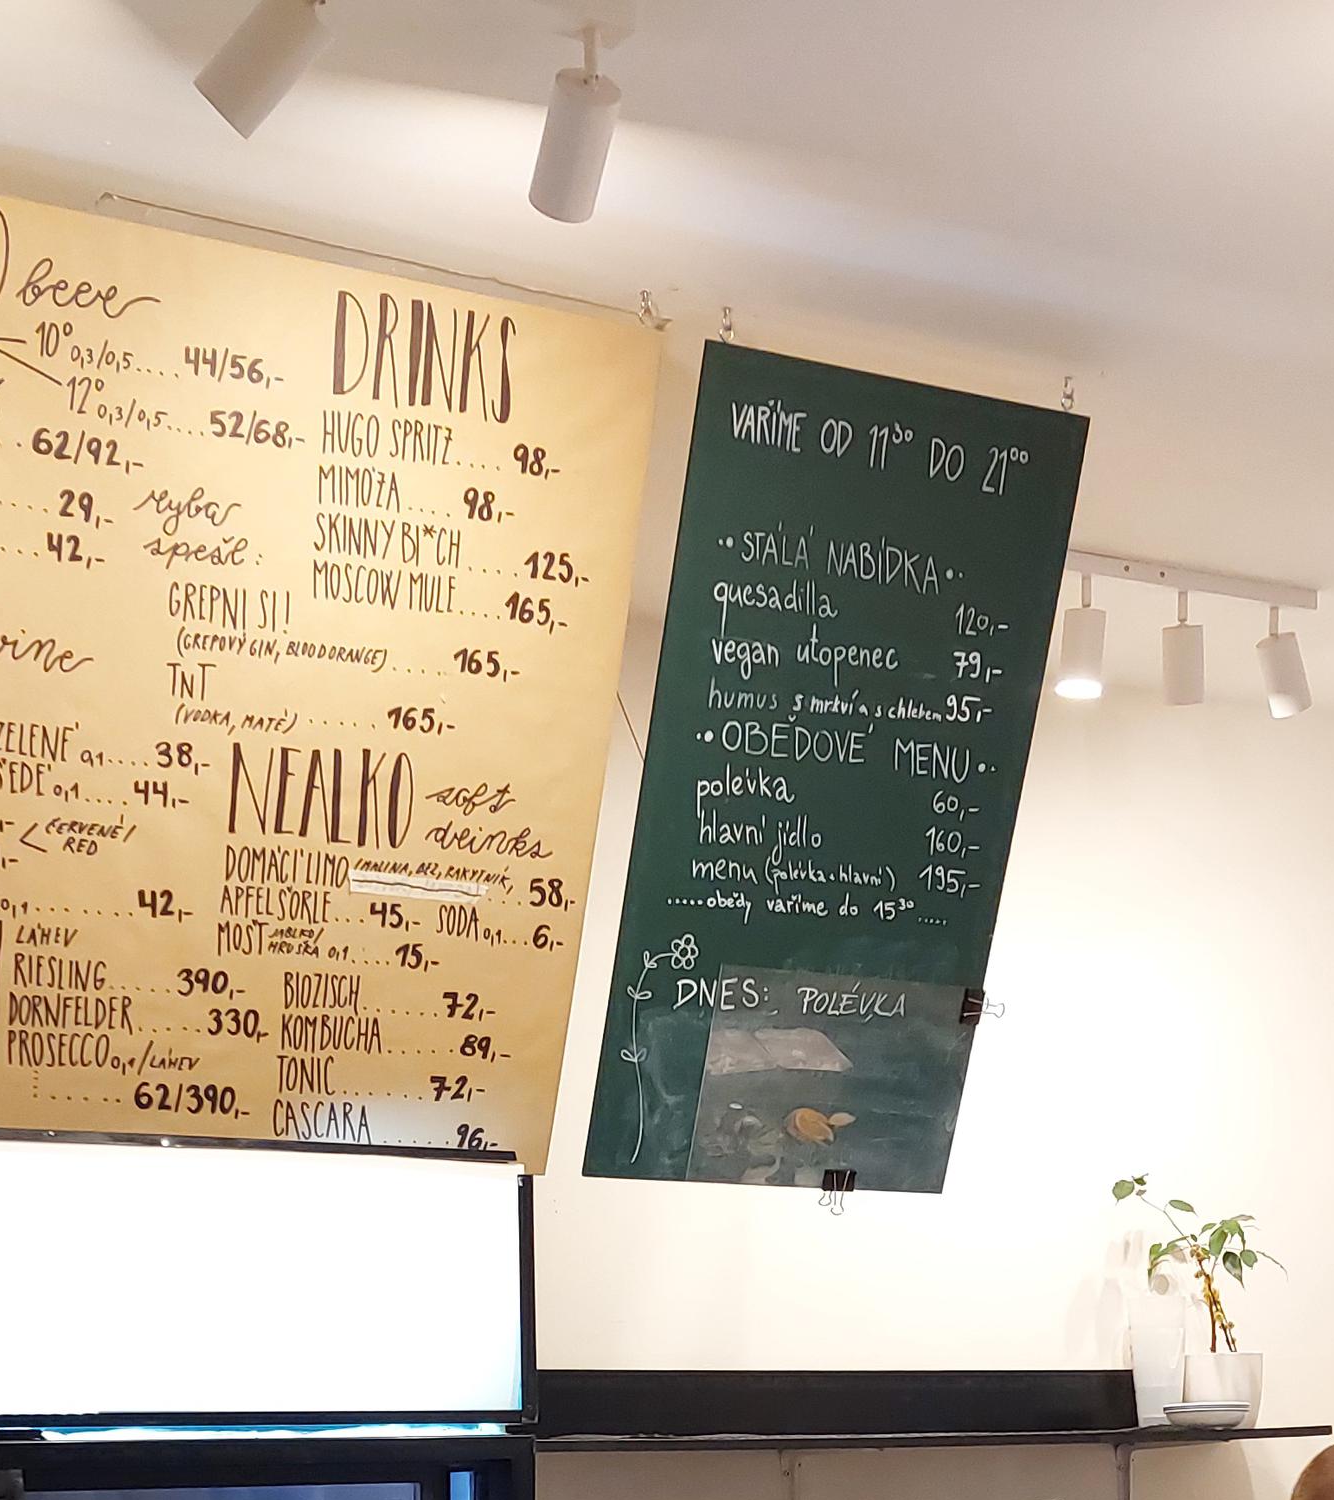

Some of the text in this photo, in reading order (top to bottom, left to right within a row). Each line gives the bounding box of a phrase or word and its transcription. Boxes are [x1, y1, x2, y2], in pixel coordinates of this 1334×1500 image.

[16, 258, 161, 318] beer
[333, 291, 516, 423] DRINKS
[323, 410, 560, 480] HUGO SPRITZ 98,-
[821, 419, 852, 457] OD
[930, 438, 964, 481] DO
[59, 489, 113, 529] 29,-
[463, 487, 515, 523] 98,-
[47, 532, 105, 570] 42,-
[314, 512, 589, 587] SKINNY 125,-
[742, 522, 938, 594] STÁLÁ NABÍDKA
[169, 581, 246, 630] GREPNI
[313, 559, 567, 635] MOSCOW MULE 165,-
[714, 579, 1008, 648] quesadilla 120,-
[453, 648, 520, 682] 165,-
[712, 623, 1002, 688] vegan utopenec 79,-
[387, 706, 455, 736] 165,-
[709, 677, 777, 709] humus
[946, 695, 992, 722] 95,-
[155, 742, 210, 776] 38,-
[722, 708, 969, 783] OBĚDOVÉ MENU
[134, 780, 189, 808] 44,-
[227, 740, 414, 850] NEALKO
[425, 783, 516, 816] soft
[933, 791, 979, 821] 60,-
[63, 837, 97, 855] RED
[425, 820, 553, 859] drinks
[700, 809, 979, 868] hlavní jídlo 160,-
[305, 851, 349, 889] LIMO
[530, 878, 575, 912] 58,-
[693, 859, 980, 898] menu 195,-
[138, 889, 193, 923] 42,-
[370, 902, 420, 932] 45,-
[436, 904, 479, 942] SODA
[533, 924, 563, 952] 6,-
[839, 893, 858, 916] do
[14, 953, 245, 1000] RIESLING 390,-
[395, 943, 439, 972] 15,-
[9, 992, 269, 1043] DORNFELDER 330,-
[284, 971, 496, 1021] BIOZISCH 72,-
[8, 1030, 109, 1067] PROSECCO
[281, 1014, 511, 1063] KOMBUCHA 89,-
[276, 1055, 485, 1102] TONIC 72,-
[273, 1099, 373, 1147] CASCARA
